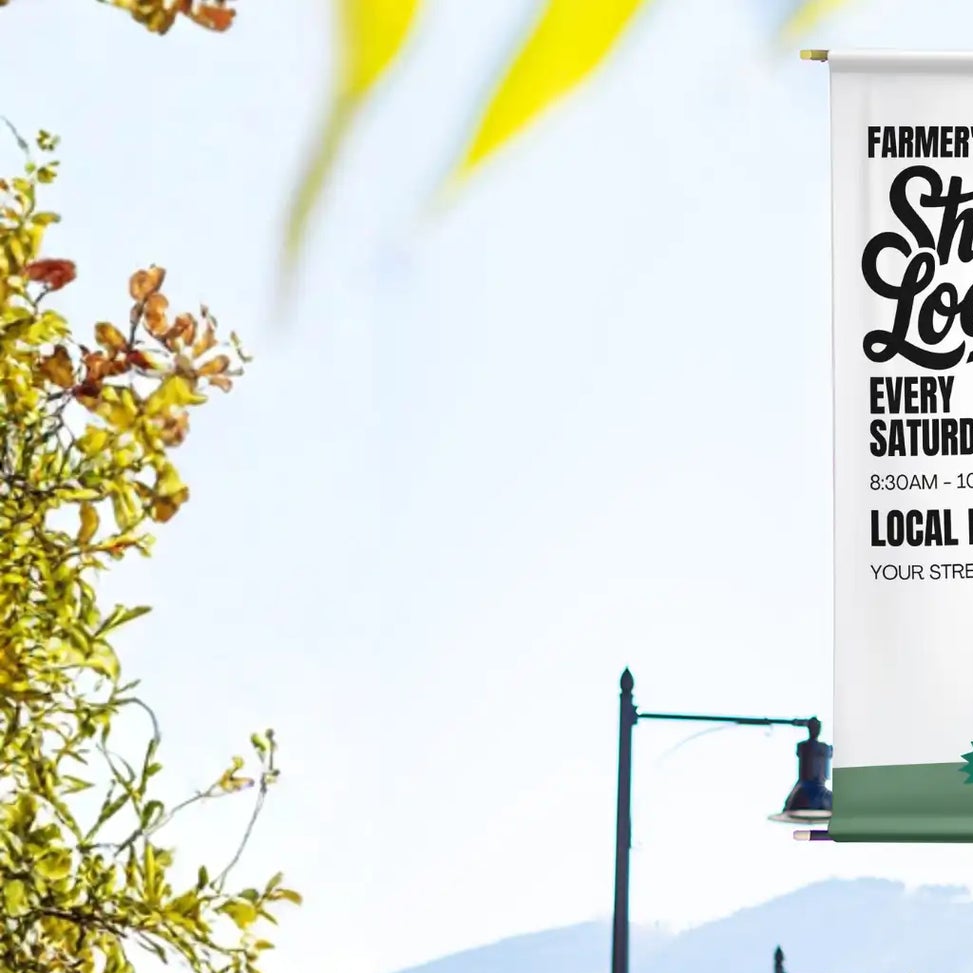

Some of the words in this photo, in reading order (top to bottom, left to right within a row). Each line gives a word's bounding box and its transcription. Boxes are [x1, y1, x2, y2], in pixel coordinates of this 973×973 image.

[869, 376, 955, 414] EVERY
[869, 473, 938, 491] 8:30AM
[870, 508, 959, 547] LOCAL
[870, 564, 925, 581] YOUR
